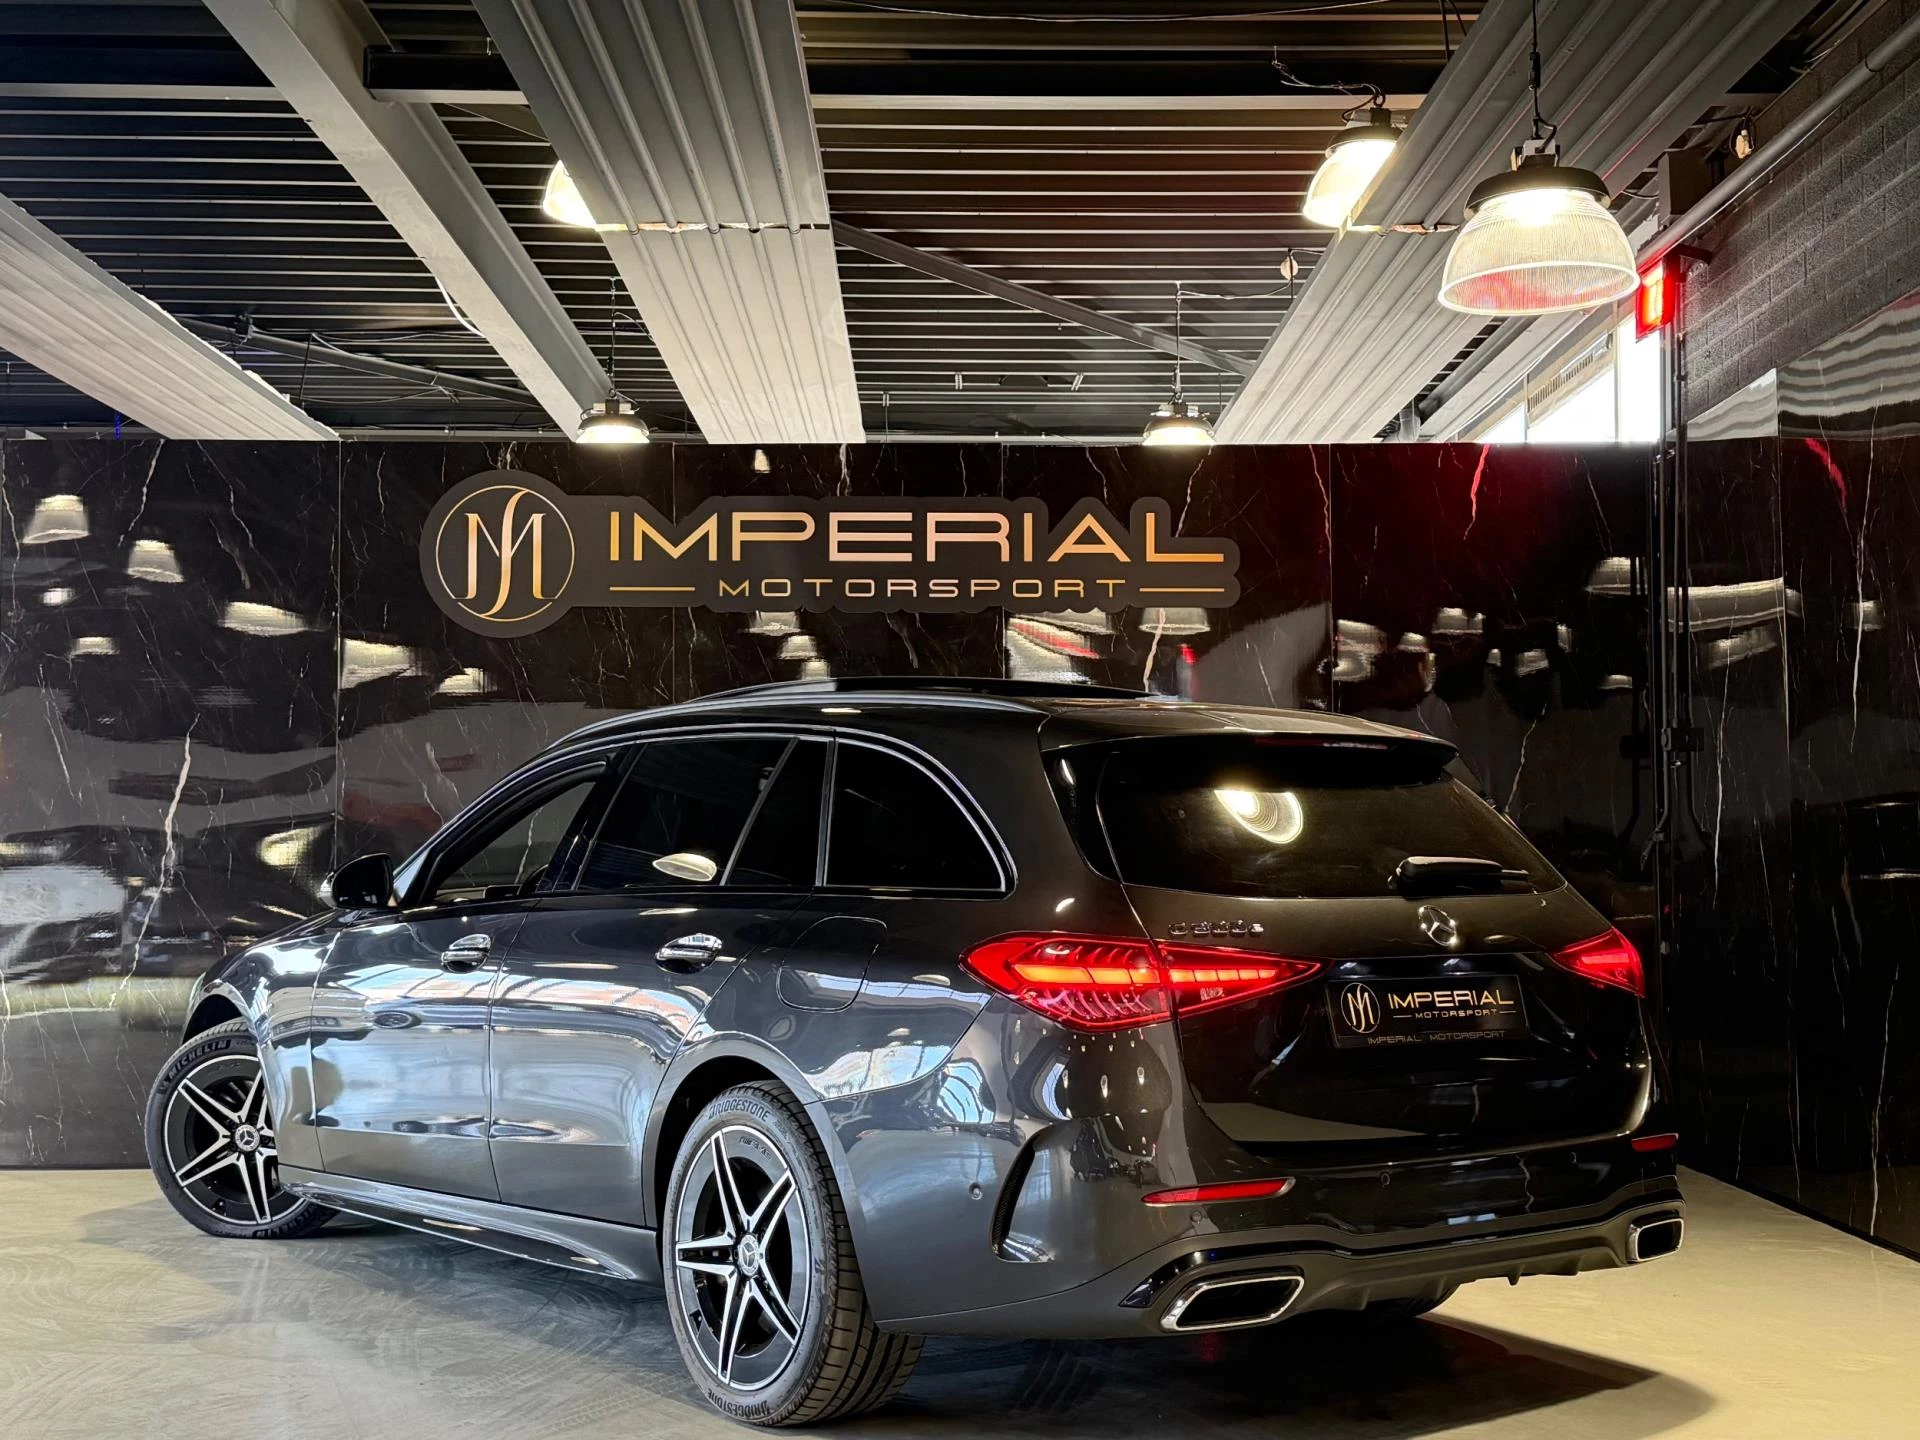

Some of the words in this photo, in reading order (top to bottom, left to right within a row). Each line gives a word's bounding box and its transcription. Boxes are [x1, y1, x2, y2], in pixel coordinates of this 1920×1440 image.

[610, 511, 1224, 563] IMPERIAL
[718, 578, 1127, 598] MOTORSPORT
[1387, 989, 1515, 1010] IMPERIAL
[1415, 1008, 1498, 1019] MOTORSPORT
[1367, 1034, 1423, 1045] IMPERIAL
[1429, 1030, 1506, 1041] MOTORSPORT
[168, 1039, 229, 1080] MICHELIN
[708, 1098, 771, 1122] BRIDGESTONE
[707, 1387, 770, 1418] BRIDGESTONE
